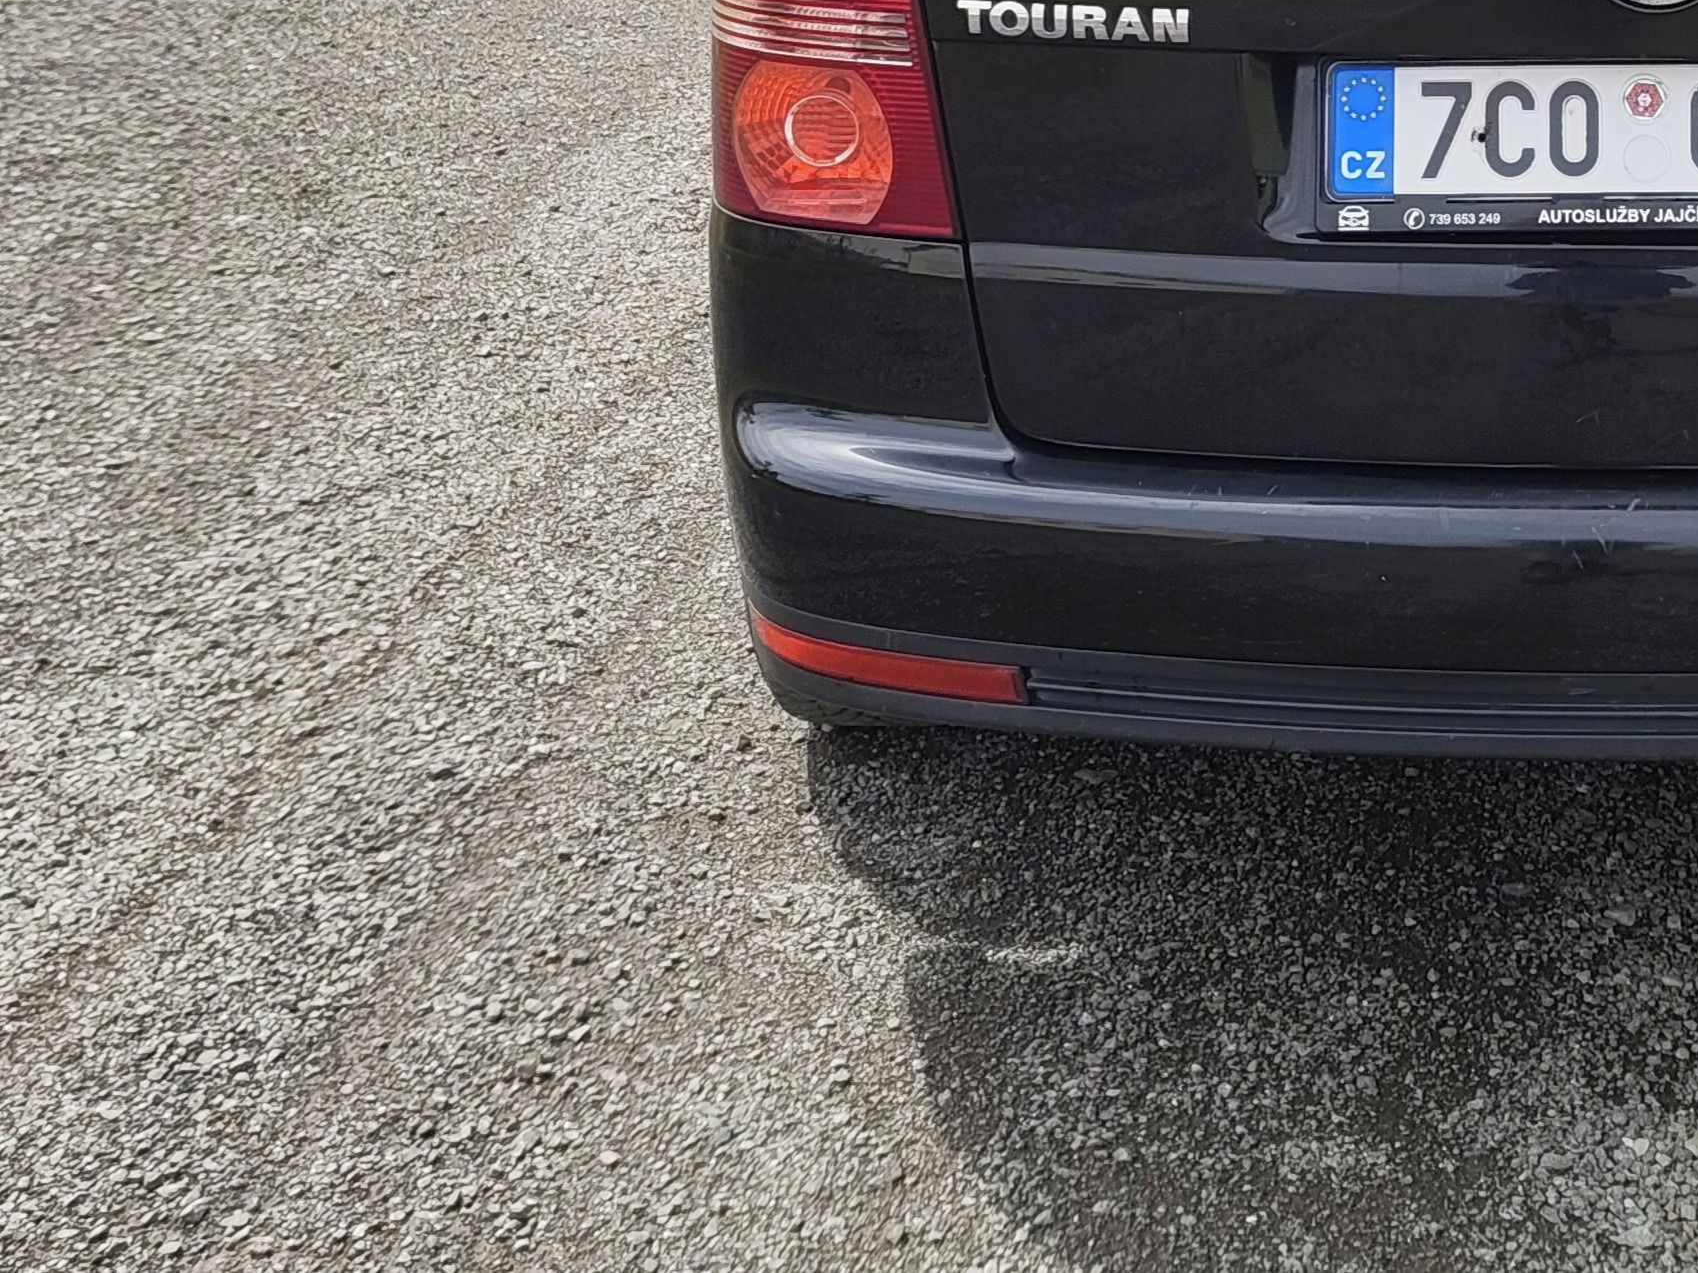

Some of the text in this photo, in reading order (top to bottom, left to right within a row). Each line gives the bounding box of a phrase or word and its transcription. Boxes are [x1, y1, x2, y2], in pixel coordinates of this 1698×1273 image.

[1420, 80, 1600, 179] 7C0
[1340, 150, 1386, 180] CZ
[1428, 212, 1502, 225] 739 653 249
[1537, 205, 1651, 224] AUTOSLUŽBY
